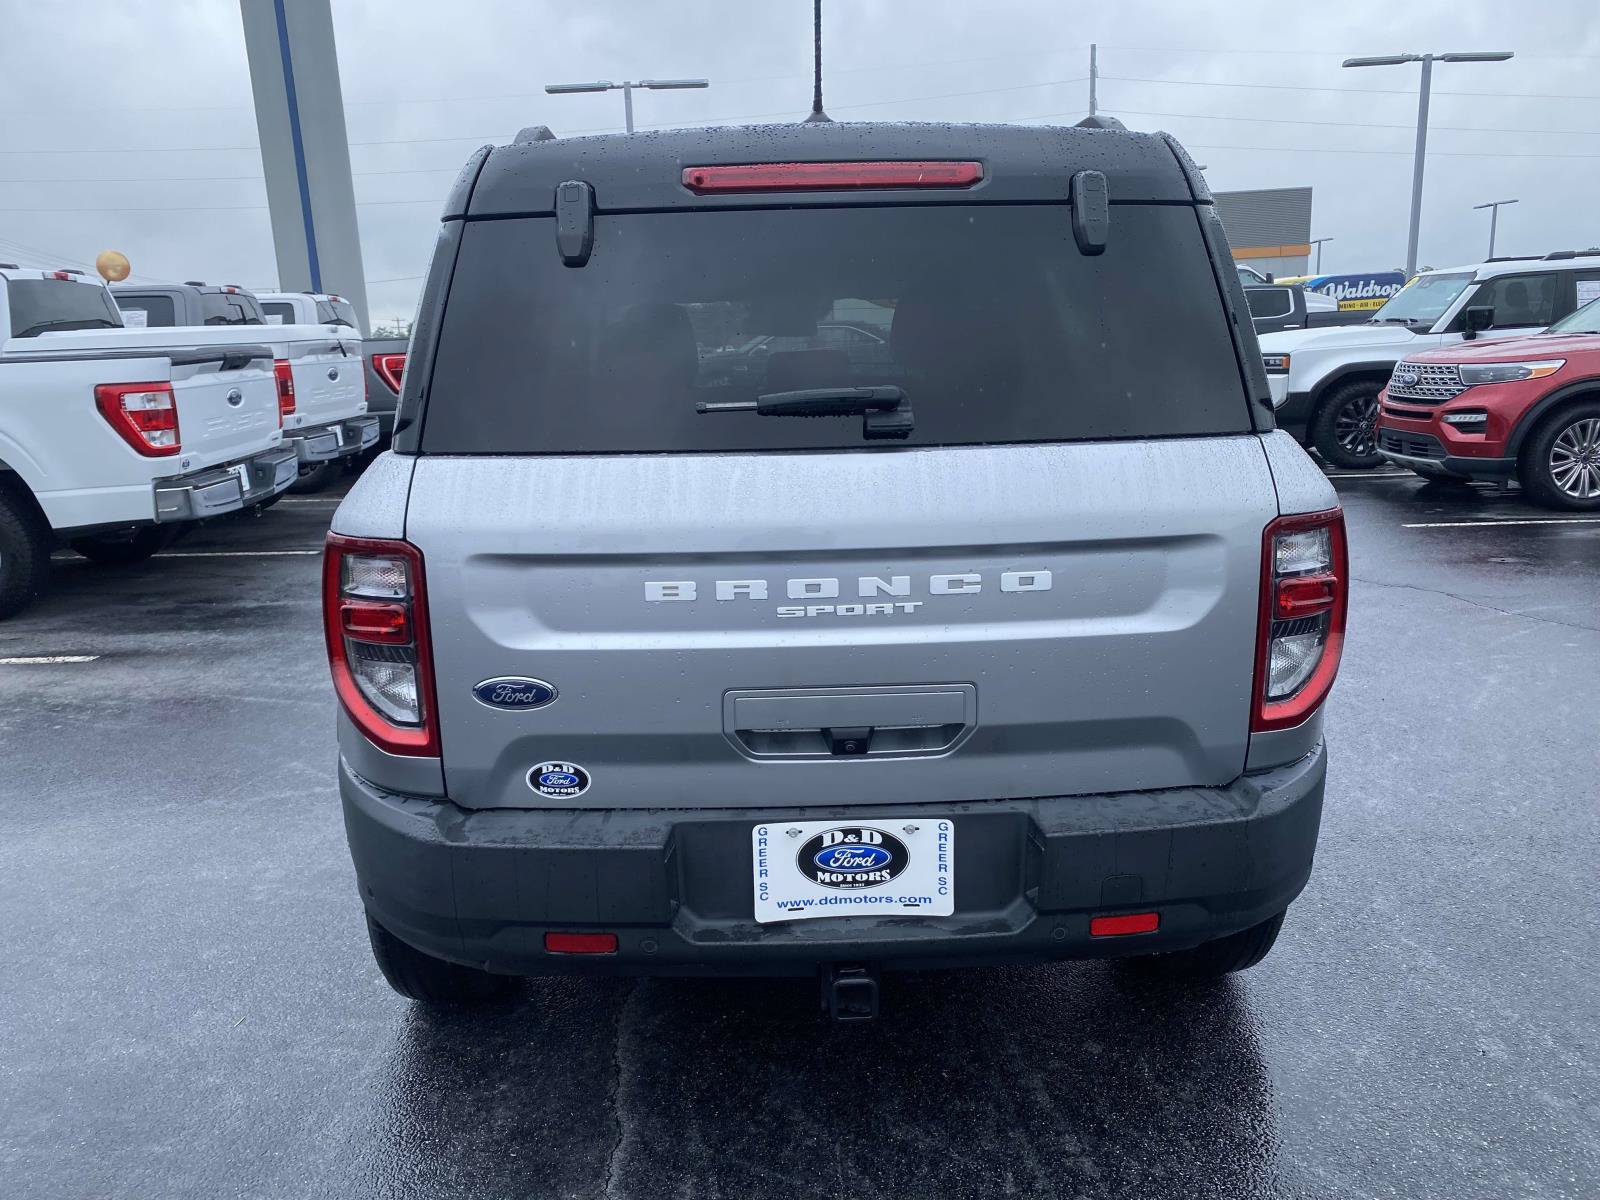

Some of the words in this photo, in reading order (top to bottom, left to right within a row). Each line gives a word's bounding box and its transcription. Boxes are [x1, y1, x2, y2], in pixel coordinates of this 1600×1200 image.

[1323, 280, 1401, 300] Waldrop
[644, 571, 1052, 601] BRONCO
[777, 602, 923, 618] SPORT
[492, 683, 537, 703] Ford
[541, 764, 575, 774] D&D
[539, 786, 580, 794] MOTORS
[546, 775, 571, 785] Ford
[821, 828, 883, 848] D&D
[938, 822, 949, 873] GREER
[758, 827, 768, 878] GREER
[829, 848, 876, 868] Ford
[816, 869, 891, 883] MOTORS
[938, 876, 948, 896] SC
[759, 882, 769, 901] SC
[777, 894, 932, 909] www.ddmotors.com
